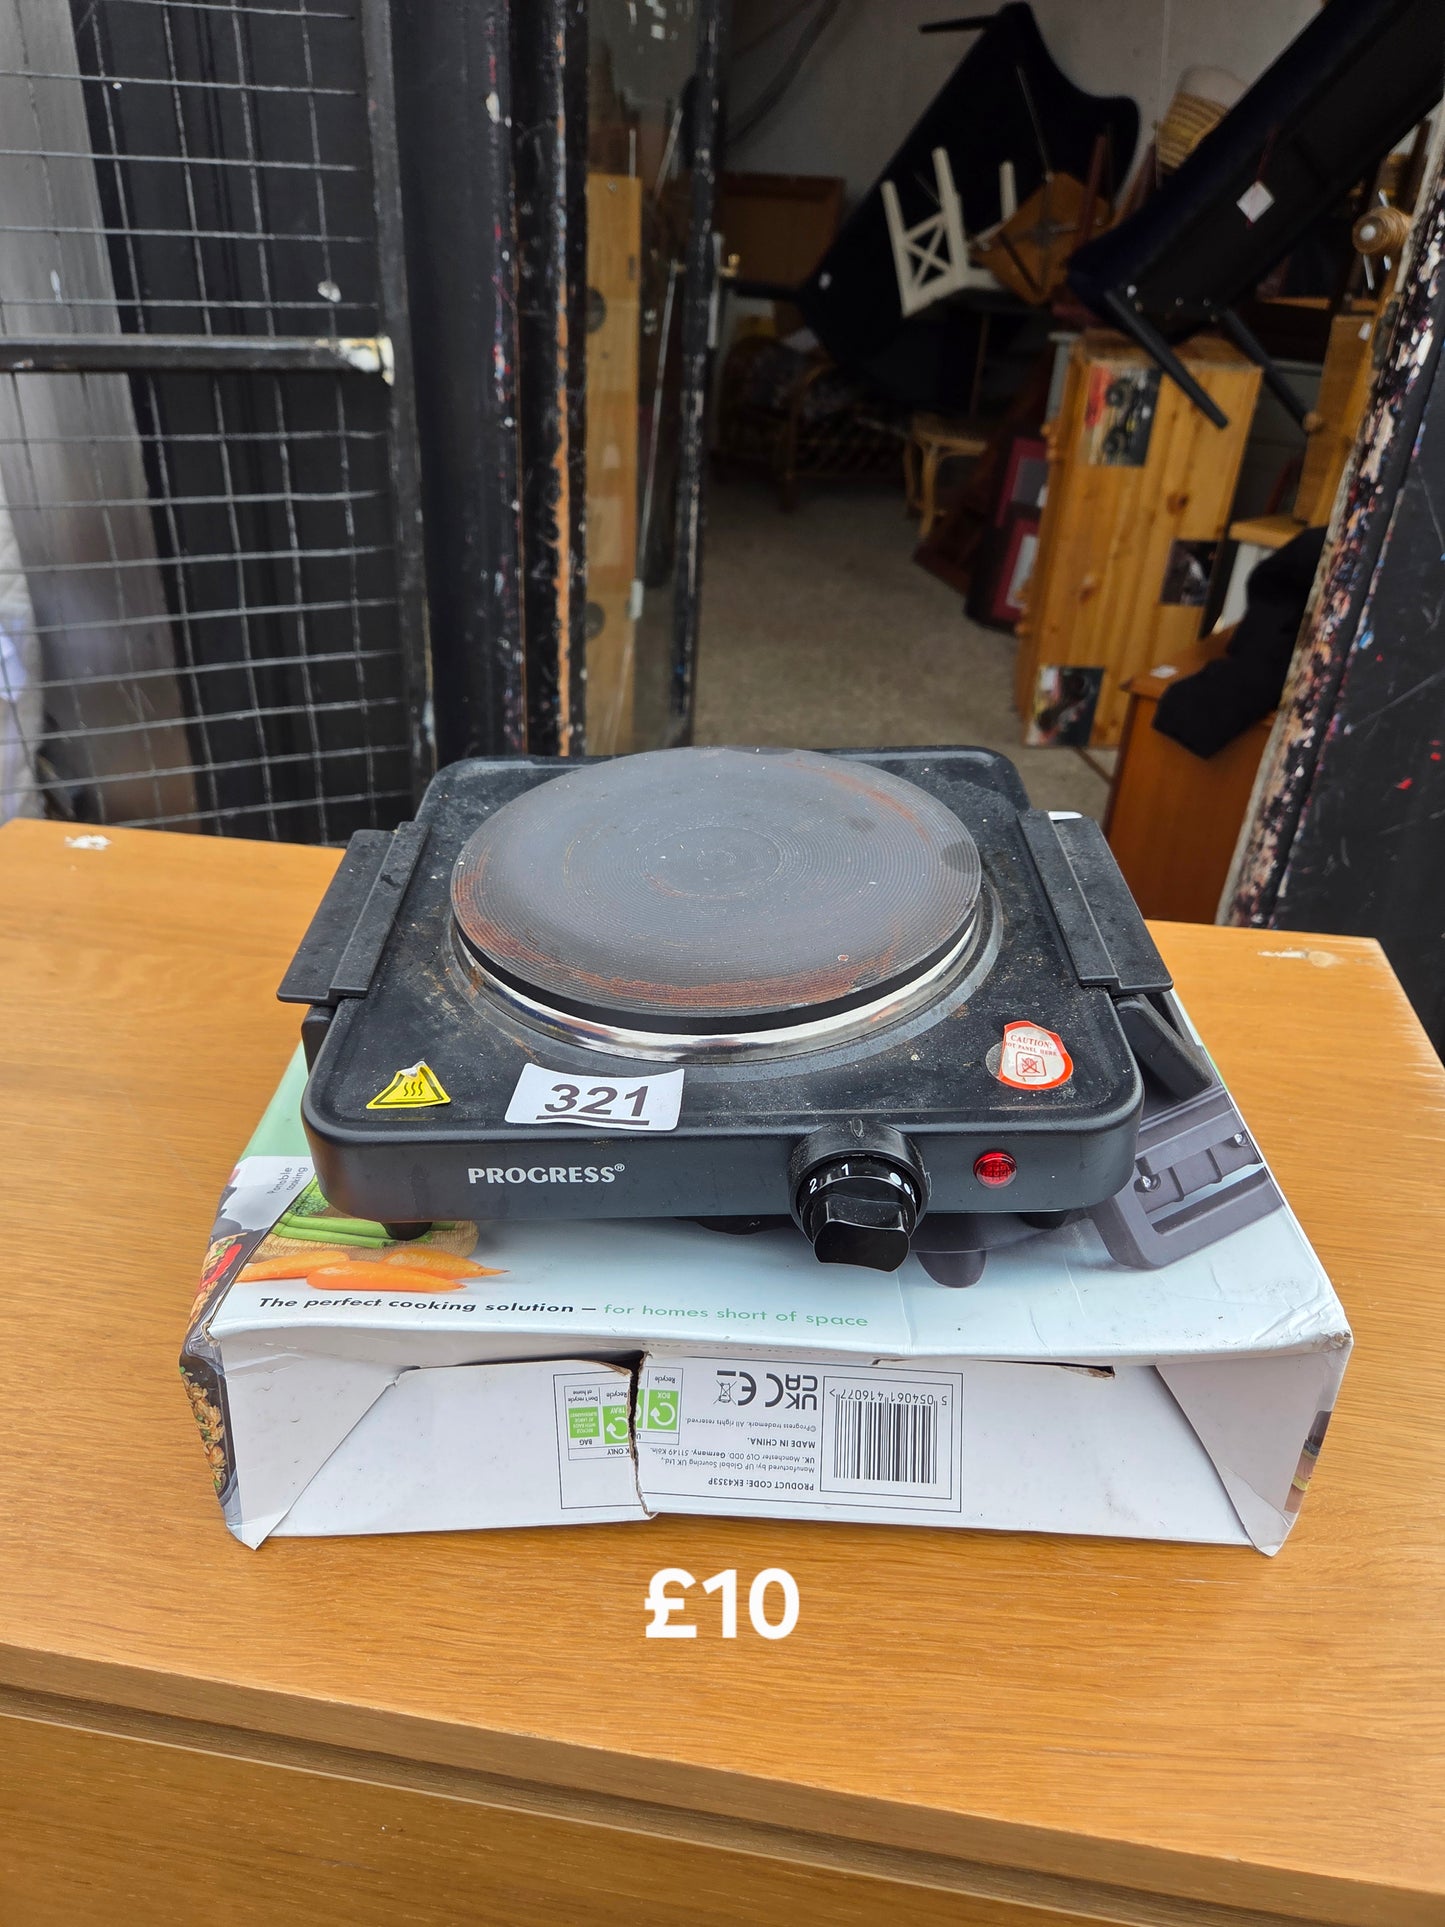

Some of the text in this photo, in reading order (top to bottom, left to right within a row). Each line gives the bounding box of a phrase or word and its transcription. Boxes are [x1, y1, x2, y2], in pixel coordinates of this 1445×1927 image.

[544, 1084, 648, 1117] 321
[841, 1164, 849, 1175] 1
[809, 1178, 817, 1194] 2
[259, 1297, 297, 1308] The
[304, 1297, 382, 1308] perfect
[389, 1299, 476, 1312] cooking
[484, 1302, 574, 1313] solution
[604, 1304, 634, 1314] for
[643, 1305, 708, 1318] homes
[716, 1308, 767, 1320] short
[776, 1311, 797, 1322] of
[806, 1314, 868, 1327] space
[655, 1375, 675, 1383] Recycle
[785, 1374, 818, 1392] CA
[606, 1390, 627, 1399] Recycle
[785, 1392, 817, 1410] UK
[747, 1437, 777, 1446] CHINA.
[791, 1440, 815, 1448] MADE
[689, 1459, 717, 1468] Sourcing
[719, 1462, 743, 1470] Global
[769, 1464, 815, 1473] Manufactured
[708, 1478, 743, 1486] EK4353P
[775, 1481, 814, 1491] PRODUCT
